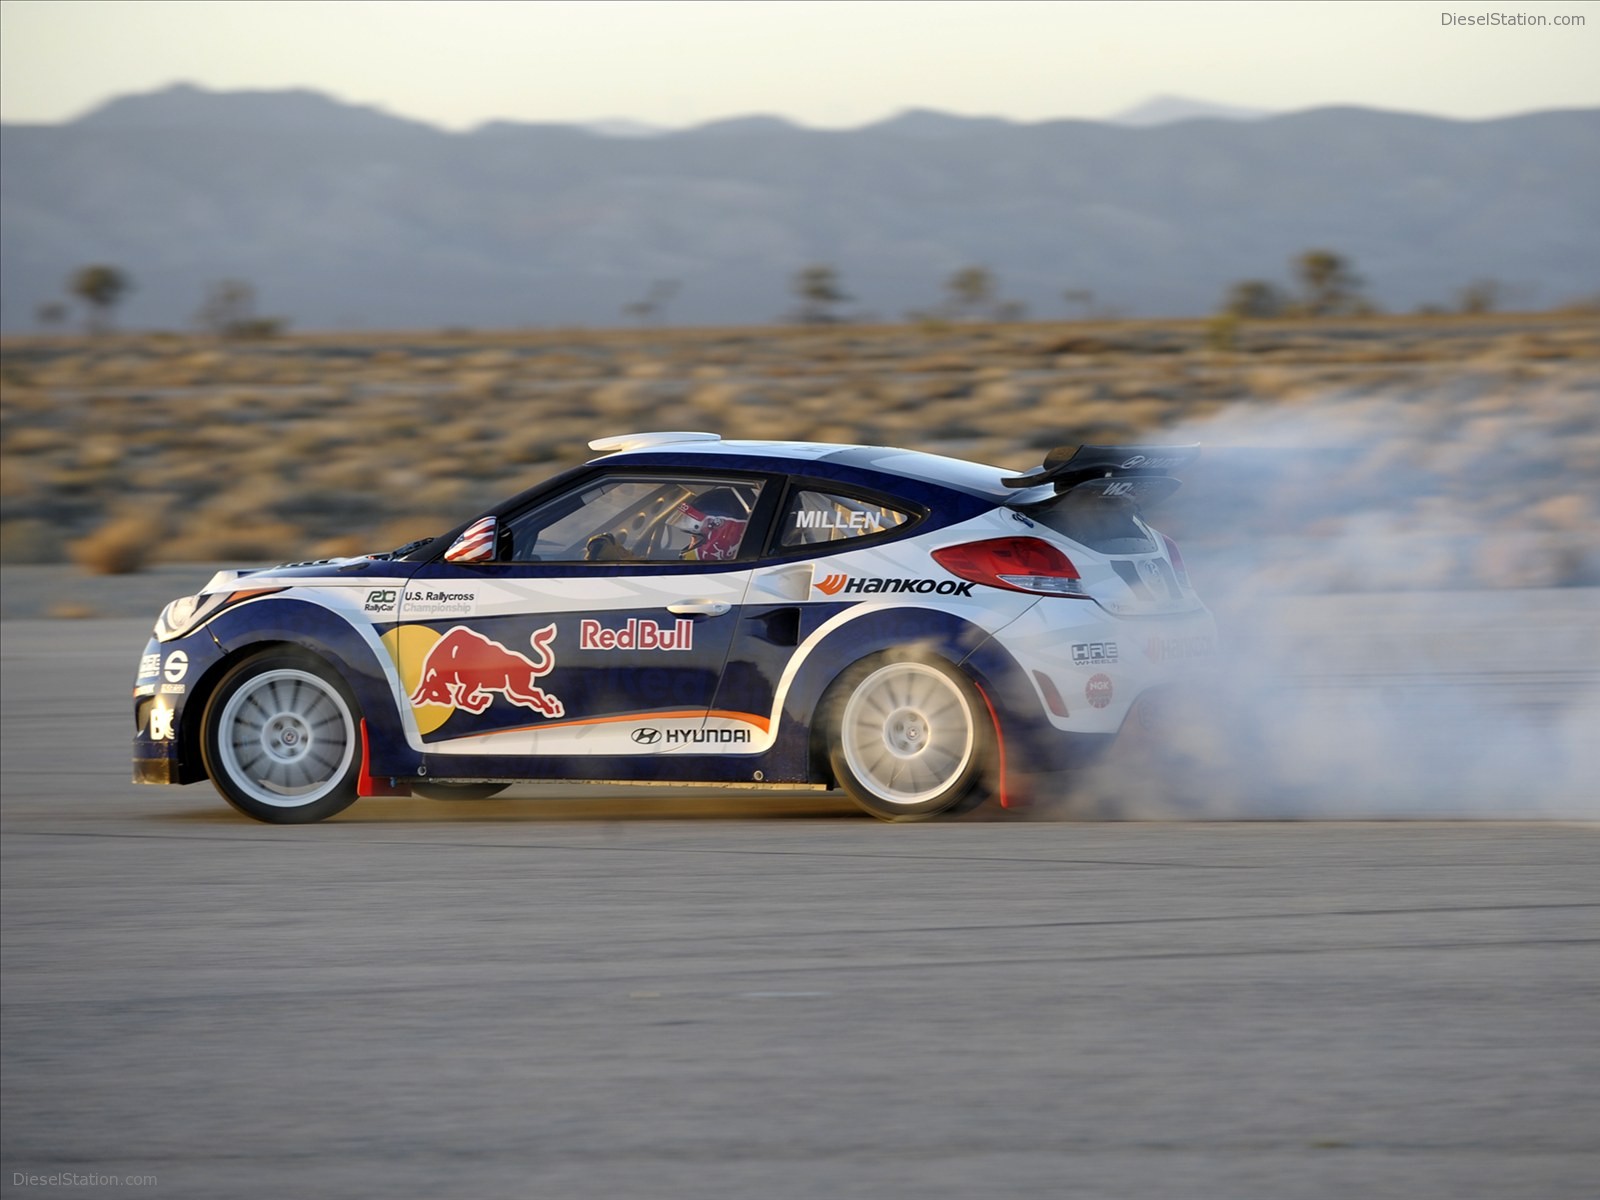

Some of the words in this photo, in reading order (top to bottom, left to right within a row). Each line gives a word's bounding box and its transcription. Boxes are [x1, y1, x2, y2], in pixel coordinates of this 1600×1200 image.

[795, 510, 880, 529] MILLEN
[404, 591, 424, 601] U.S.
[425, 591, 475, 603] Rallycross
[364, 604, 395, 613] RallyCar
[403, 602, 472, 614] Championship
[1071, 642, 1119, 661] HRE
[1089, 681, 1110, 691] NGK
[666, 729, 751, 743] HYUNDAI
